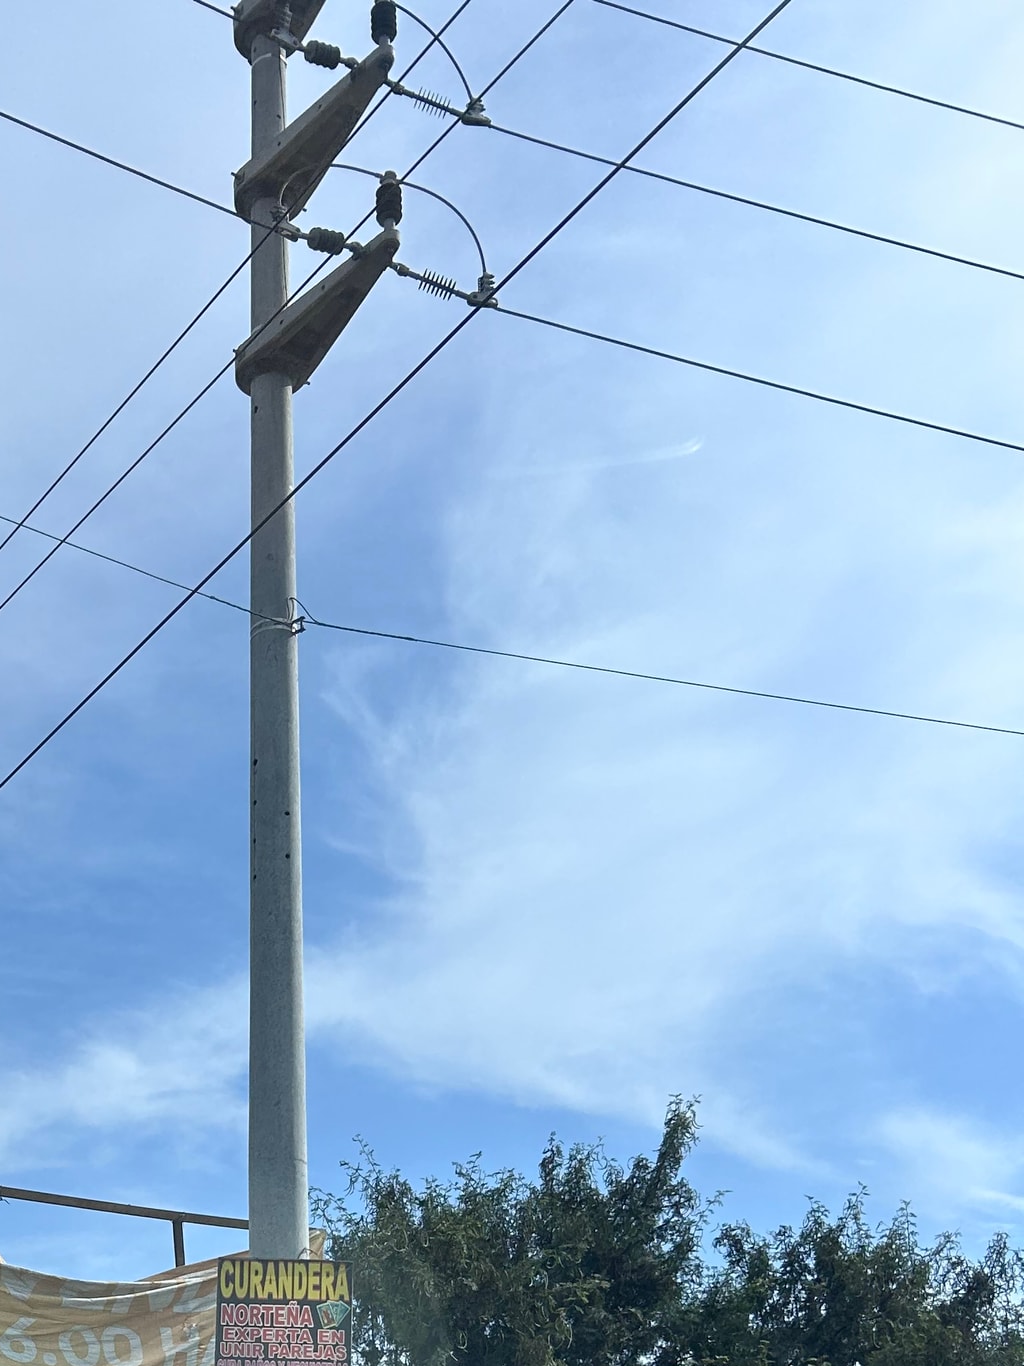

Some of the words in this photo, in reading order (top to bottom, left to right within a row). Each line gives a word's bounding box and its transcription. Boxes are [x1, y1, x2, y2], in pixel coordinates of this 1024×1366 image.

[220, 1260, 350, 1301] CURANDERA
[220, 1301, 314, 1328] NORTEÑA
[222, 1327, 312, 1344] EXPERTA
[318, 1330, 345, 1345] EN
[219, 1343, 264, 1359] UNIR
[268, 1345, 347, 1361] PAREJAS
